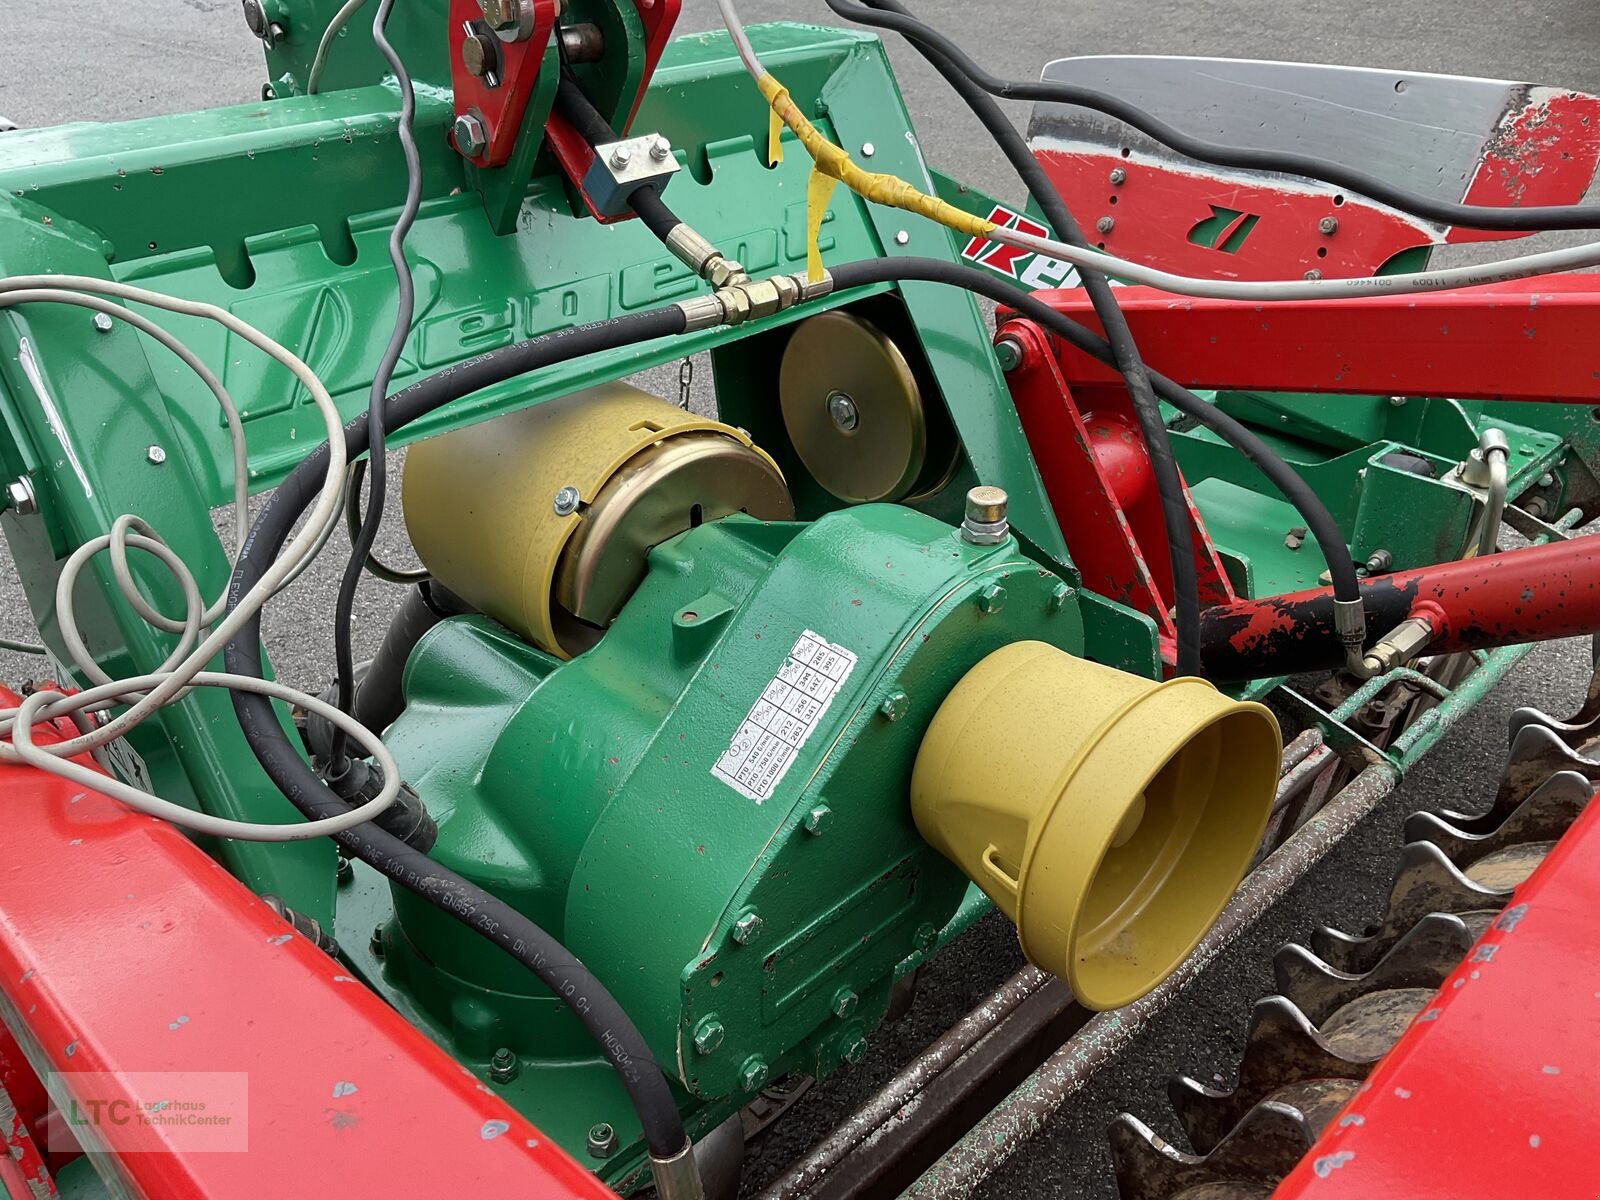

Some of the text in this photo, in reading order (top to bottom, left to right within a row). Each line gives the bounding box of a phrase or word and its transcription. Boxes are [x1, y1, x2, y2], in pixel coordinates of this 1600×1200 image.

[737, 767, 750, 781] PTO
[749, 748, 762, 764] 540
[799, 672, 812, 688] 344
[812, 650, 825, 666] 285
[747, 773, 759, 787] PTO
[759, 756, 770, 771] 750
[780, 720, 793, 736] 212
[794, 698, 807, 714] 256
[809, 677, 822, 693] 447
[822, 656, 835, 672] 395
[756, 780, 769, 794] PTO
[766, 762, 779, 781] 1000
[790, 726, 803, 742] 283
[804, 705, 817, 720] 341
[384, 858, 404, 877] 100
[442, 895, 476, 918] EN857
[512, 938, 530, 956] DN
[530, 952, 546, 969] 10
